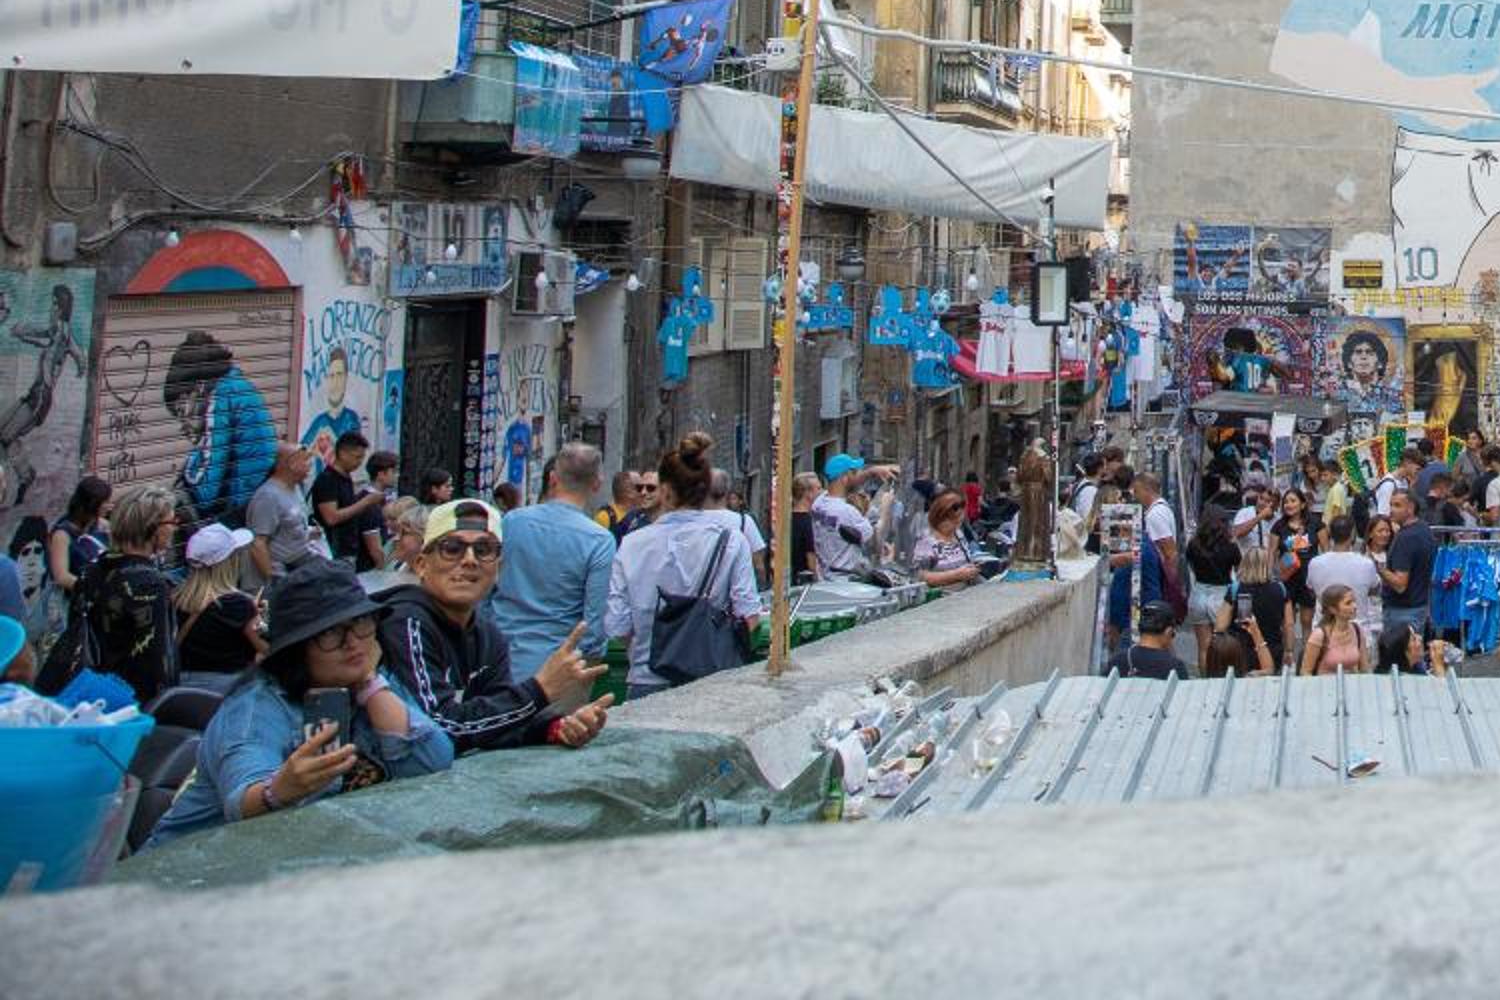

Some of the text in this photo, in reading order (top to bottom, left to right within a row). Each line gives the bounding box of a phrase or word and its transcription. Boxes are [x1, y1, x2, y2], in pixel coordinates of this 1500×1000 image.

[1403, 247, 1439, 282] 10
[1197, 290, 1298, 303] LOS DOS MEJORES
[1195, 304, 1217, 315] SON
[308, 299, 392, 359] LORENZO
